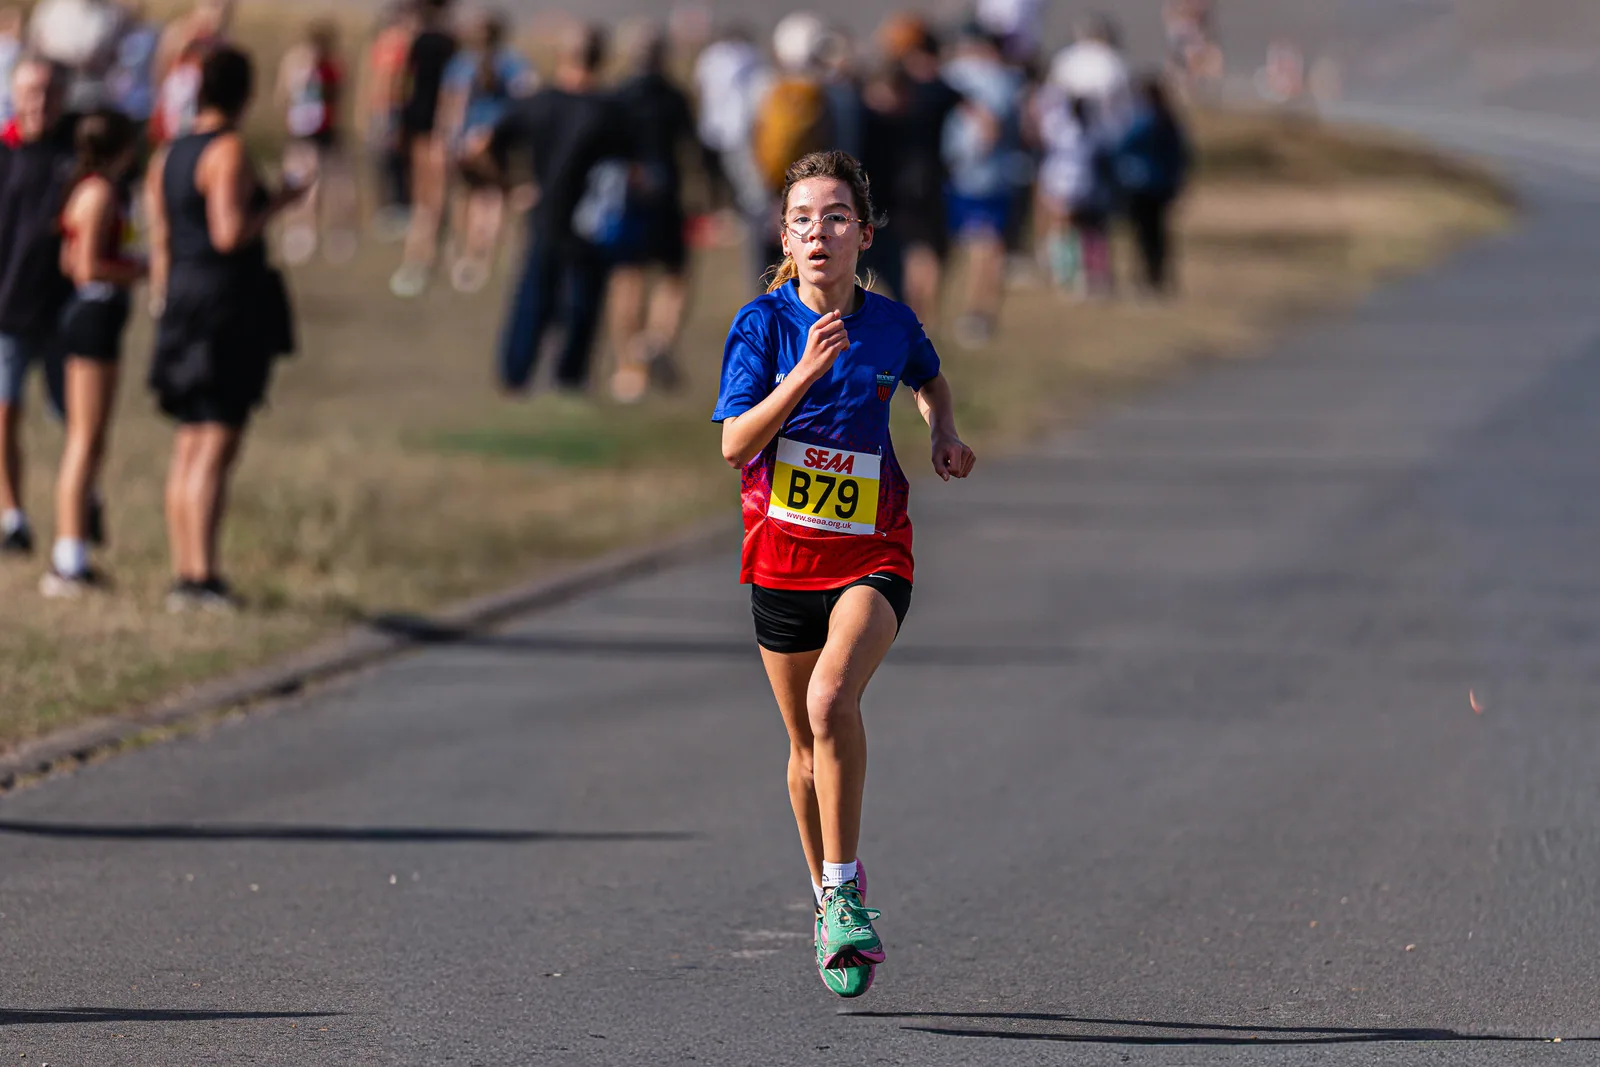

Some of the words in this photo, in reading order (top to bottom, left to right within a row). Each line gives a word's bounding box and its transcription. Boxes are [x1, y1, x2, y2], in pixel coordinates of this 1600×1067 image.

[803, 447, 855, 474] SEAA
[787, 469, 859, 519] B79
[786, 511, 852, 529] www.seaa.org.uk
